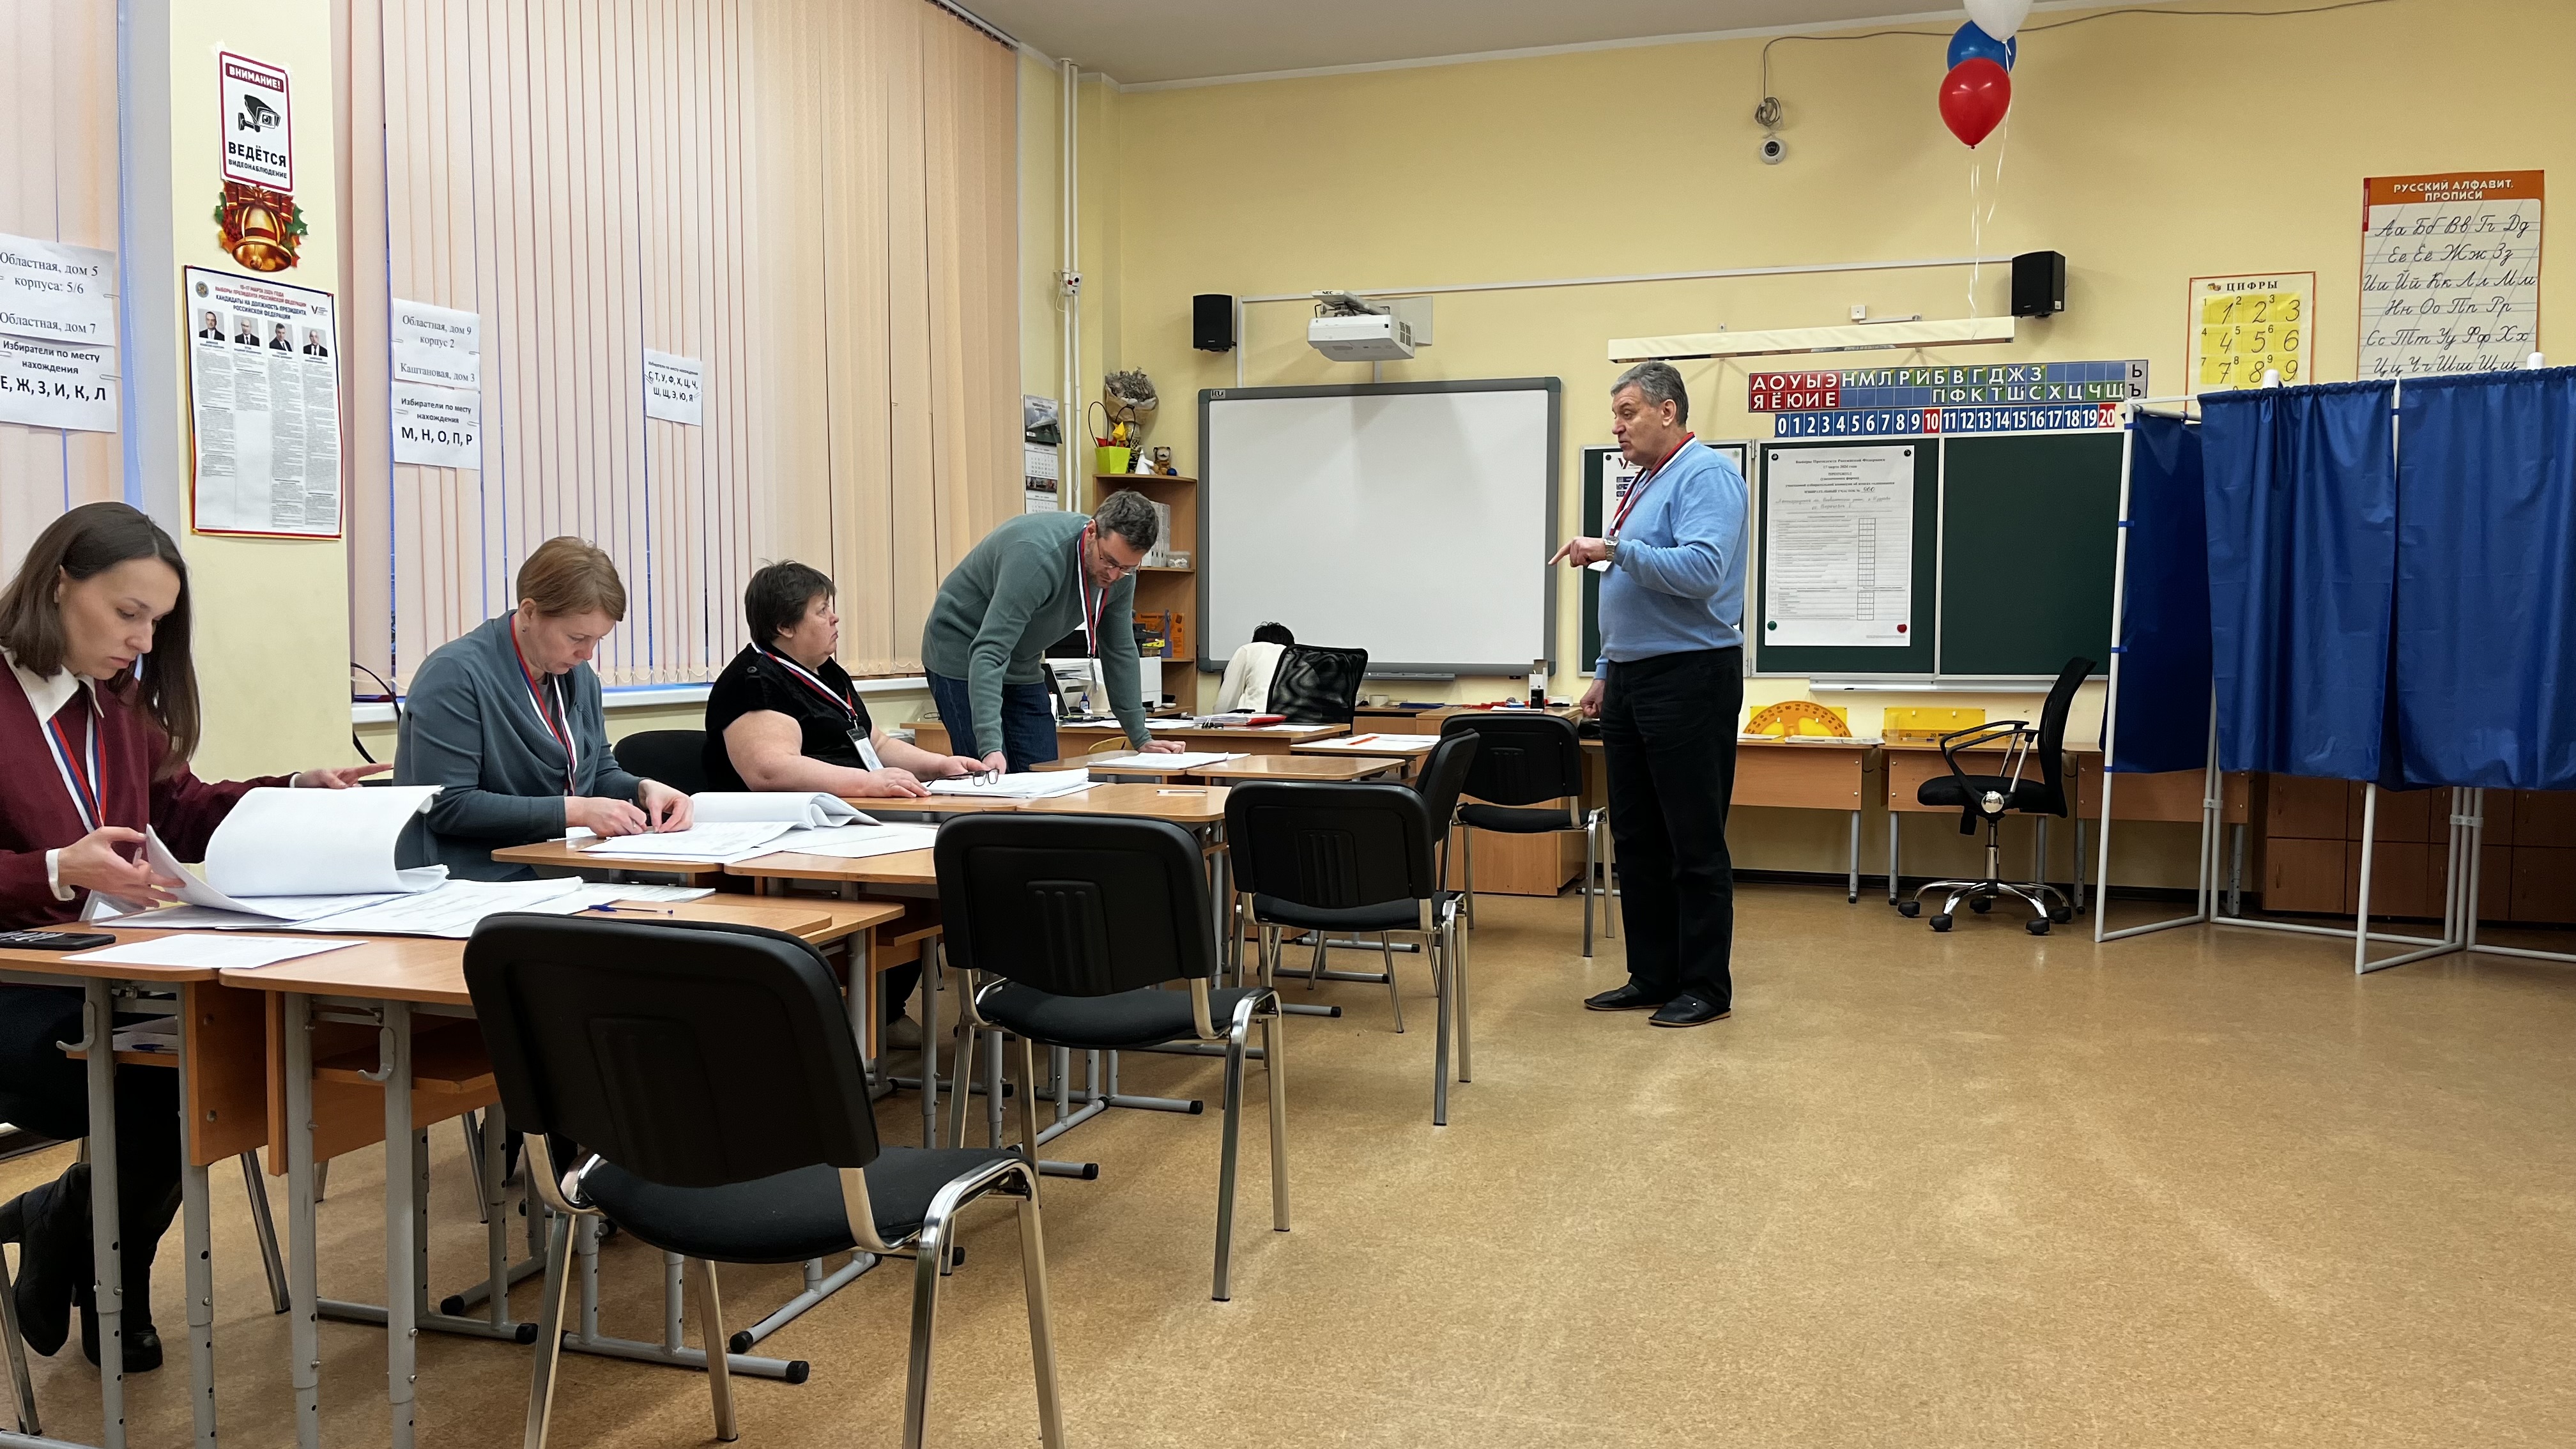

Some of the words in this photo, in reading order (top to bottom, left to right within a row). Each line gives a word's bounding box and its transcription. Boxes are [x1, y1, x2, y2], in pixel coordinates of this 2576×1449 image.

[229, 66, 281, 89] ВНИМАНИЕ!
[228, 141, 286, 167] ВЕДЁТСЯ
[229, 159, 287, 179] ВИДЕОНАБЛЮДЕНИЕ
[2394, 180, 2449, 193] РУССКИЙ
[2452, 179, 2514, 190] АЛФАВИТ.
[2425, 191, 2483, 201] ПРОПИСИ
[2375, 219, 2407, 236] Аа
[2412, 217, 2447, 234] Бб
[2444, 216, 2472, 234] Вв
[2474, 215, 2496, 233] Гг
[2503, 214, 2529, 238] Дд
[0, 252, 61, 273] Областная,
[65, 265, 88, 275] дом
[91, 266, 98, 277] 5
[2388, 246, 2407, 263] Ее
[2414, 242, 2433, 262] Ёё
[2440, 244, 2487, 261] Жж
[2492, 242, 2514, 266] Зз
[15, 277, 63, 291] корпуса:
[66, 282, 84, 294] 5/6
[2227, 280, 2278, 292] ЦИФРЫ
[2363, 275, 2389, 291] Ии
[2395, 270, 2421, 290] Йй
[2426, 272, 2452, 289] Кк
[2456, 271, 2490, 287] Лл
[2494, 269, 2536, 286] Мм
[2204, 298, 2207, 306] 1
[2222, 302, 2234, 325] 1
[2236, 296, 2242, 305] 2
[2252, 301, 2267, 323] 2
[2269, 295, 2275, 303] 3
[2285, 299, 2300, 322] 3
[2385, 299, 2413, 316] Нн
[2419, 298, 2440, 314] Оо
[2447, 298, 2478, 313] Пп
[2486, 296, 2512, 318] Рр
[0, 312, 62, 332] Областная,
[65, 323, 86, 333] дом
[89, 323, 96, 334] 7
[402, 315, 448, 333] Областная,
[449, 326, 464, 335] дом
[466, 326, 471, 335] 9
[420, 336, 448, 348] корпус
[450, 339, 454, 348] 2
[2202, 328, 2207, 336] 4
[2220, 332, 2232, 354] 4
[2235, 326, 2241, 335] 5
[2251, 331, 2266, 353] 5
[2268, 325, 2274, 334] 6
[2284, 330, 2299, 352] 6
[2366, 330, 2386, 346] Сс
[2391, 329, 2431, 346] Тт
[2436, 327, 2457, 351] Уу
[2462, 326, 2491, 350] Фф
[2496, 325, 2529, 342] Хх
[3, 340, 54, 356] Избиратели
[71, 353, 100, 363] месту
[22, 360, 79, 374] нахождения
[400, 362, 452, 380] Каштановая,
[453, 374, 468, 382] дом
[470, 373, 475, 382] 3
[2201, 357, 2207, 366] 7
[2218, 362, 2232, 384] 7
[2234, 356, 2239, 365] 8
[2249, 361, 2265, 383] 8
[2267, 355, 2273, 363] 9
[2283, 360, 2298, 382] 9
[2373, 358, 2403, 378] Цц
[2409, 356, 2431, 372] Чч
[2436, 355, 2473, 372] Шш
[2478, 355, 2518, 372] Щщ
[0, 375, 13, 392] Е,
[16, 378, 34, 395] Ж,
[38, 381, 50, 397] З,
[55, 383, 70, 400] И,
[75, 385, 89, 401] К,
[95, 387, 106, 401] Л
[401, 398, 443, 409] Избиратели
[454, 406, 471, 414] месту
[417, 413, 459, 424] нахождения
[1778, 417, 1787, 434] 0
[1793, 417, 1800, 434] 1
[1807, 417, 1816, 433] 2
[1821, 417, 1830, 433] 3
[1836, 416, 1846, 433] 4
[1851, 415, 1860, 432] 5
[1866, 415, 1875, 431] 6
[1882, 415, 1890, 431] 7
[1896, 414, 1905, 431] 8
[1911, 413, 1920, 431] 9
[1925, 413, 1939, 430] 10
[1943, 413, 1956, 429] 11
[1960, 412, 1974, 429] 12
[1977, 411, 1991, 429] 13
[1995, 411, 2009, 428] 14
[2012, 410, 2027, 428] 15
[2030, 410, 2044, 427] 16
[2048, 410, 2062, 427] 17
[2065, 409, 2080, 427] 18
[2082, 409, 2097, 426] 19
[2099, 408, 2115, 426] 20
[401, 427, 418, 442] М,
[422, 429, 434, 444] Н,
[438, 431, 450, 445] О,
[452, 433, 463, 447] П,
[466, 434, 473, 445] Р
